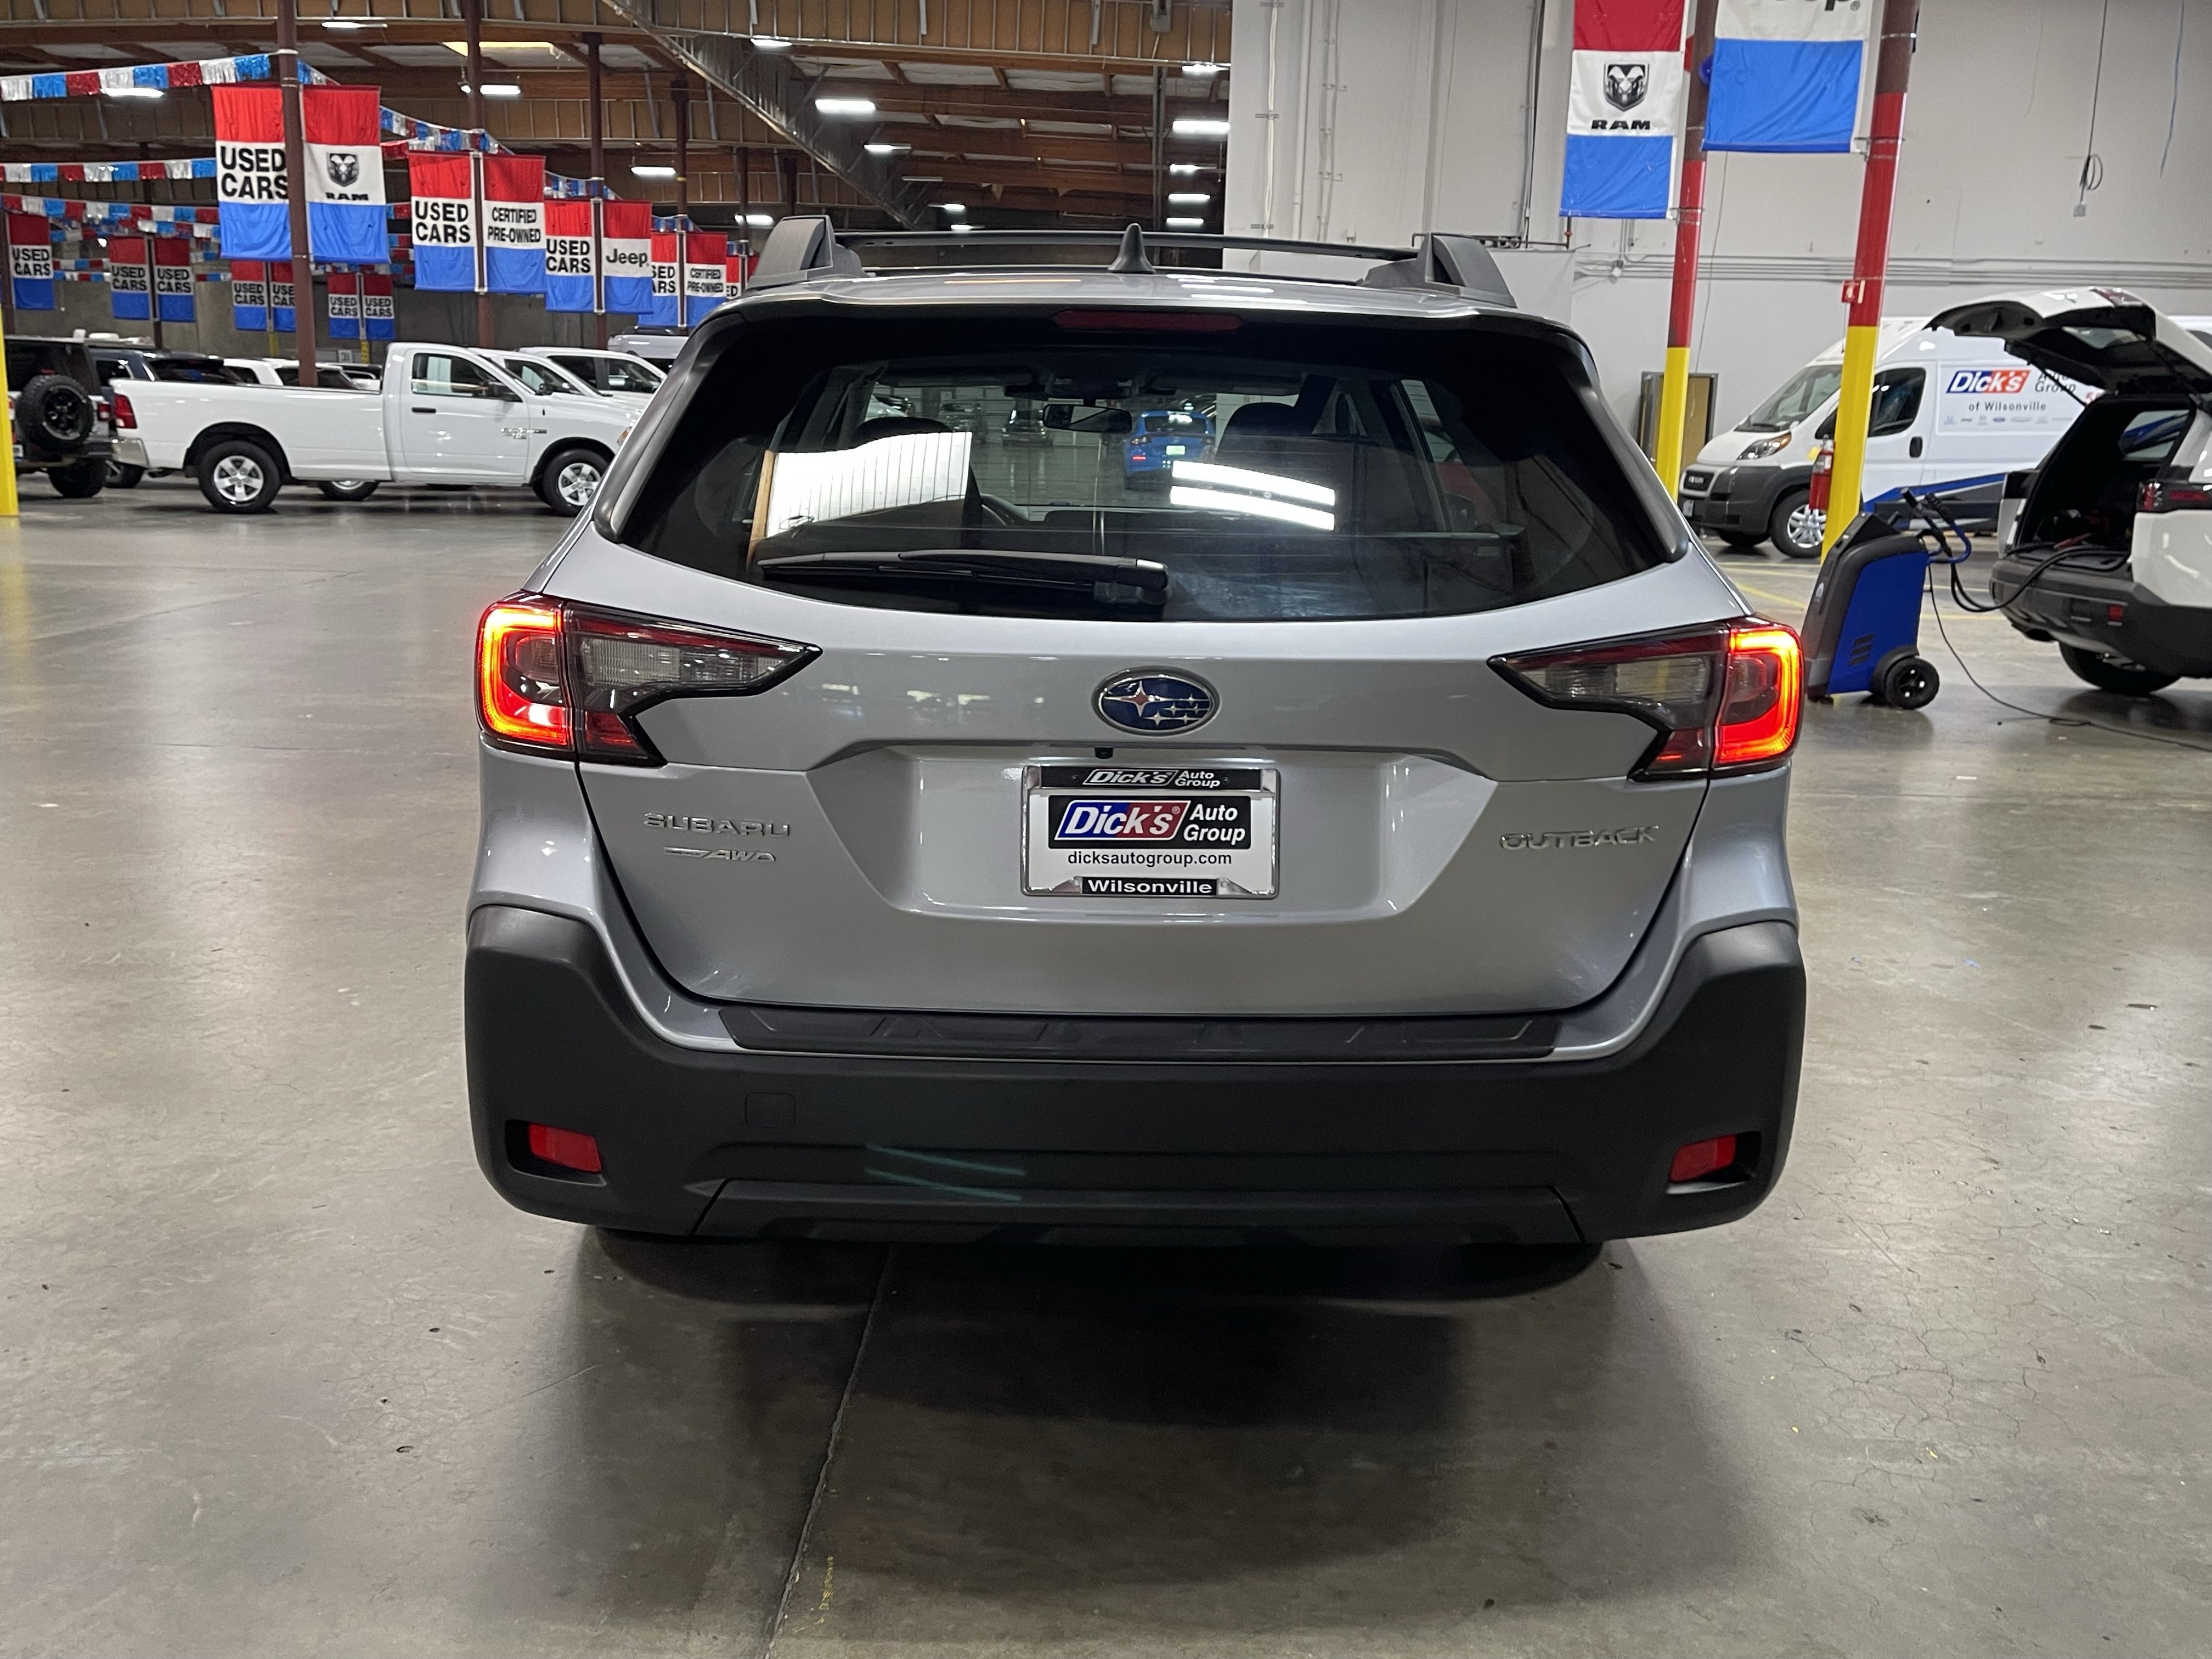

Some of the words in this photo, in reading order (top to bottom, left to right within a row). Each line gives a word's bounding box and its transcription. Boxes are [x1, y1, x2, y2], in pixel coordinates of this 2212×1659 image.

[1591, 120, 1650, 130] RAM
[221, 146, 286, 172] USED
[222, 173, 288, 199] CARS
[326, 192, 369, 201] RAM
[415, 200, 469, 222] USED
[492, 207, 537, 223] CERTIFIED
[416, 222, 471, 243] CARS
[488, 225, 541, 243] PRE-OWNED
[546, 239, 590, 256] USED
[13, 248, 49, 261] USED
[606, 248, 648, 267] Jeep
[14, 263, 50, 275] CARS
[546, 256, 591, 273] CARS
[111, 265, 145, 278] USED
[157, 268, 189, 280] USED
[652, 266, 675, 279] SED
[112, 279, 147, 291] CARS
[157, 281, 191, 292] CARS
[234, 283, 263, 294] USED
[273, 284, 294, 295] USE
[235, 295, 264, 304] CARS
[273, 296, 295, 306] CAR
[330, 297, 357, 306] USED
[365, 297, 391, 307] USED
[331, 307, 358, 316] CARS
[365, 308, 392, 317] CARS
[1950, 371, 2020, 392] Dick's
[1969, 402, 1979, 411] of
[1985, 402, 2046, 411] Wilsonville
[1090, 770, 1169, 784] Dick's
[1177, 770, 1214, 779] Auto
[1174, 778, 1220, 788] Group
[1189, 804, 1238, 821] Auto
[644, 812, 789, 837] SUBARU
[1064, 805, 1173, 835] Dick's
[1183, 825, 1246, 845] Group
[1500, 826, 1659, 850] OUTBACK
[704, 850, 776, 861] AWD
[1068, 851, 1232, 867] dicksautogroup.com
[1088, 879, 1212, 894] Wilsonville
